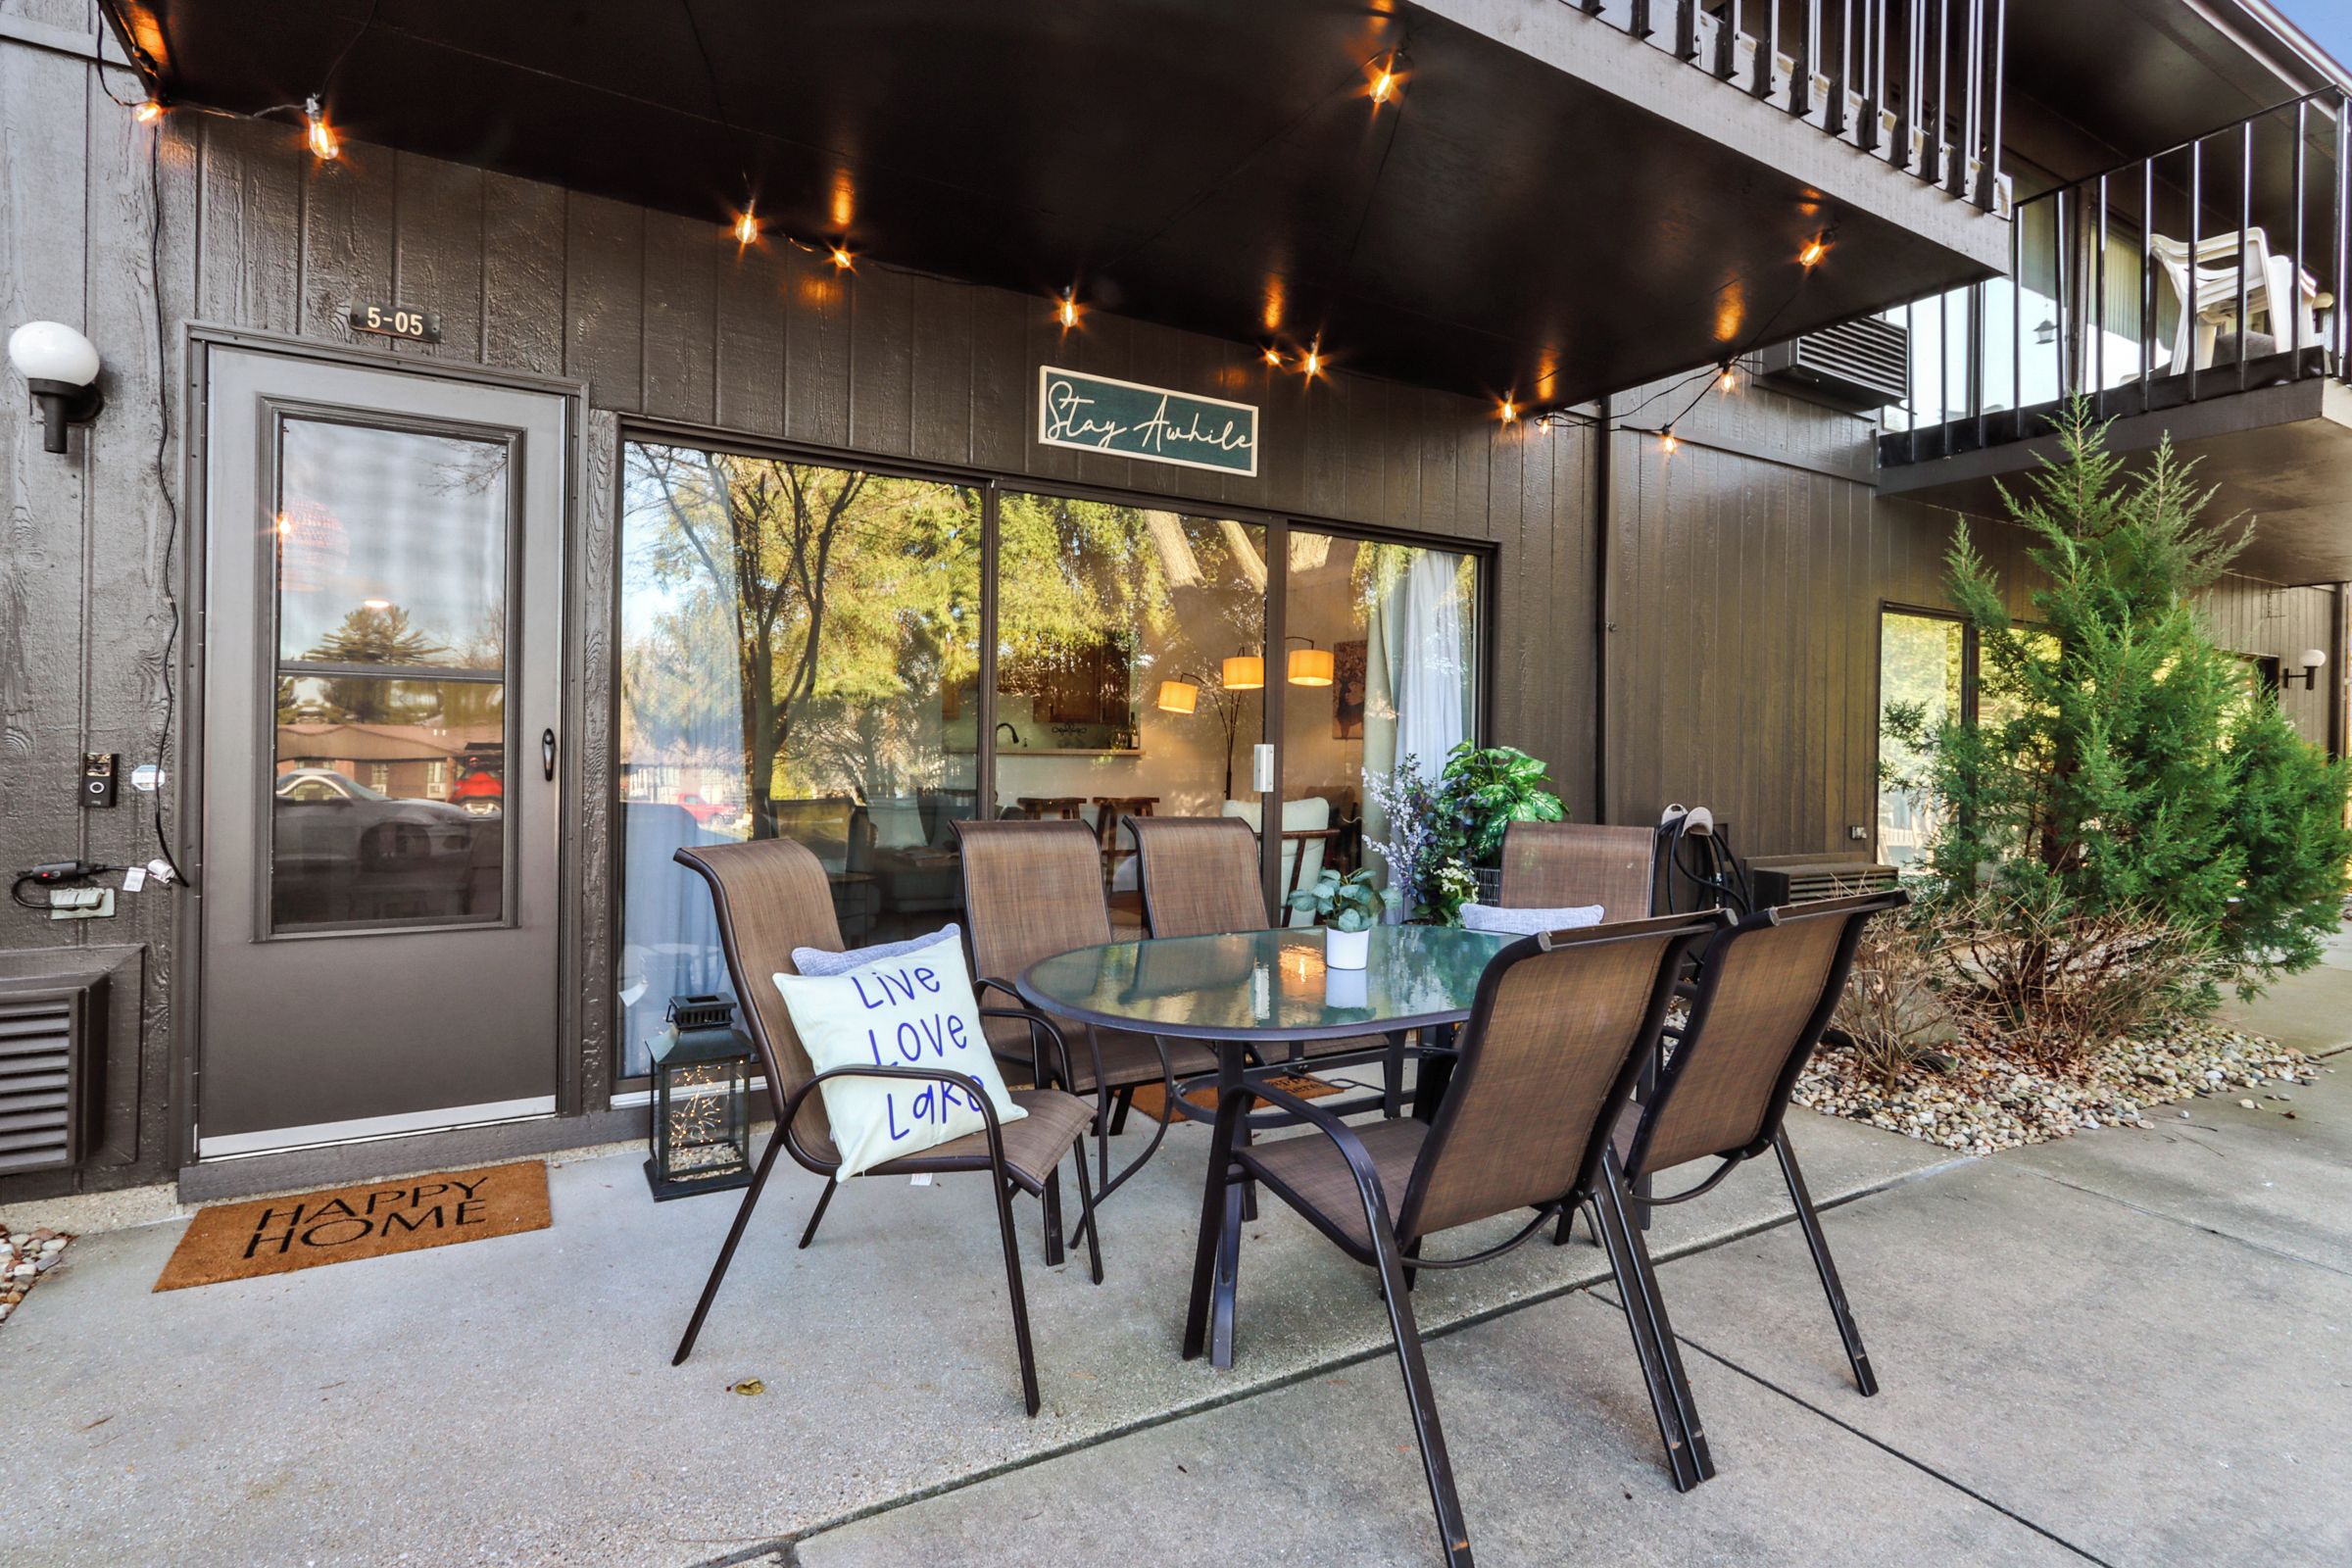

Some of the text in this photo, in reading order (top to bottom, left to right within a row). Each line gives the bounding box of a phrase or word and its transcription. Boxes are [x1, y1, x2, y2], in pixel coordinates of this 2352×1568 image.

[367, 307, 423, 335] 5-05
[1048, 380, 1252, 452] Stay Awhile
[243, 1199, 487, 1258] HOME
[257, 1177, 488, 1231] HAPPY
